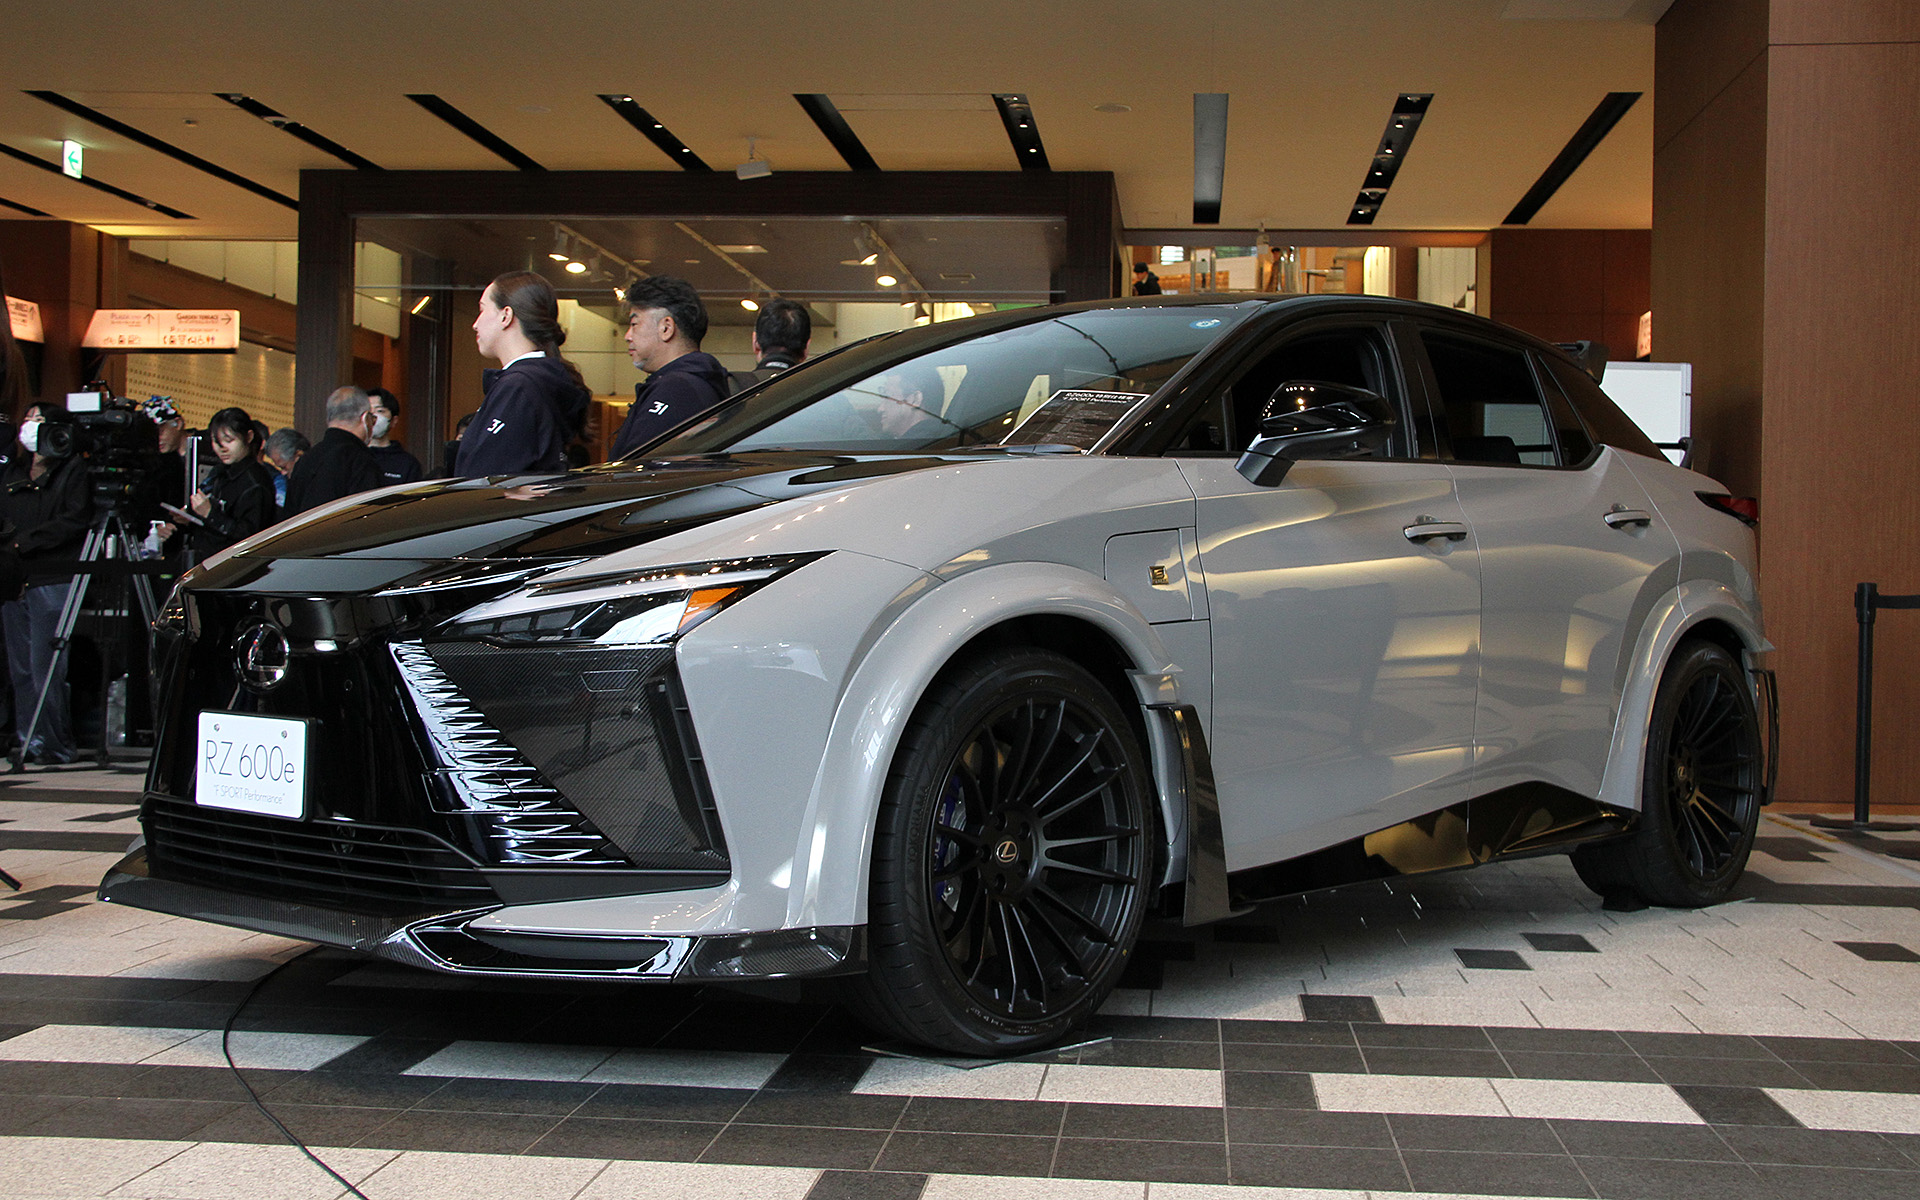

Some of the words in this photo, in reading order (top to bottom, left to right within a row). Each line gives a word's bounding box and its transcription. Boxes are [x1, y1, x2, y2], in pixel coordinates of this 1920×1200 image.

[205, 740, 233, 775] RZ
[239, 743, 295, 783] 600e
[220, 785, 243, 799] SPORT
